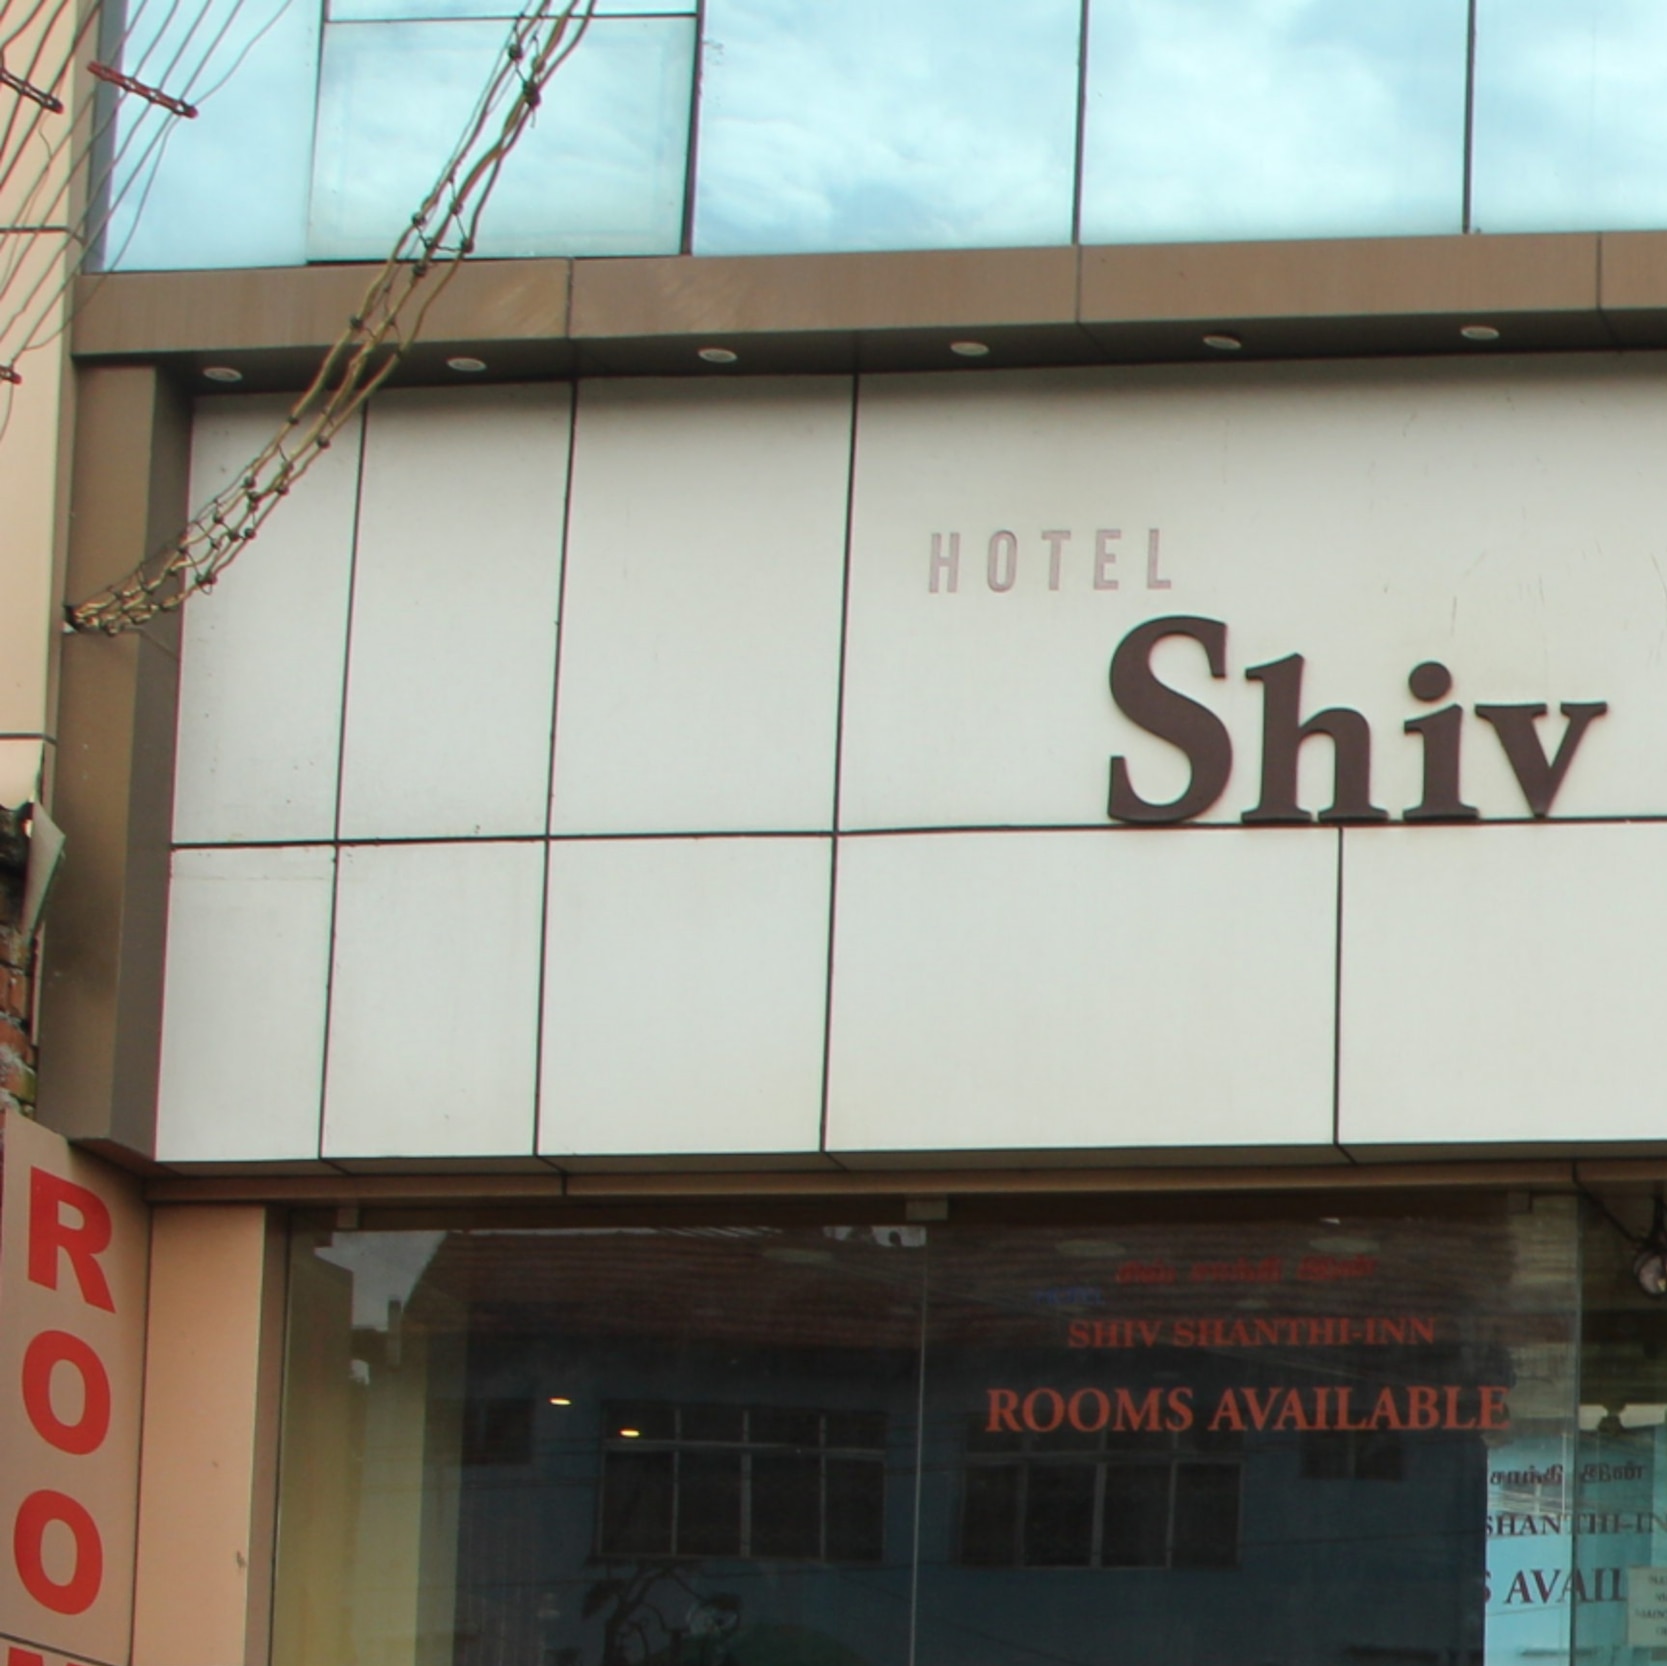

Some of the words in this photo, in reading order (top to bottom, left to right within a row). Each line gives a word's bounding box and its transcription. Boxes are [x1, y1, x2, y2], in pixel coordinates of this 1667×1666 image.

[927, 526, 1173, 595] HOTEL
[1106, 613, 1608, 824] Shiv
[1068, 1319, 1164, 1349] SHIV
[1172, 1316, 1437, 1348] SHANTHI-INN
[984, 1386, 1195, 1433] ROOMS
[1207, 1384, 1513, 1431] AVAILABLE
[1503, 1567, 1629, 1605] AVAIL
